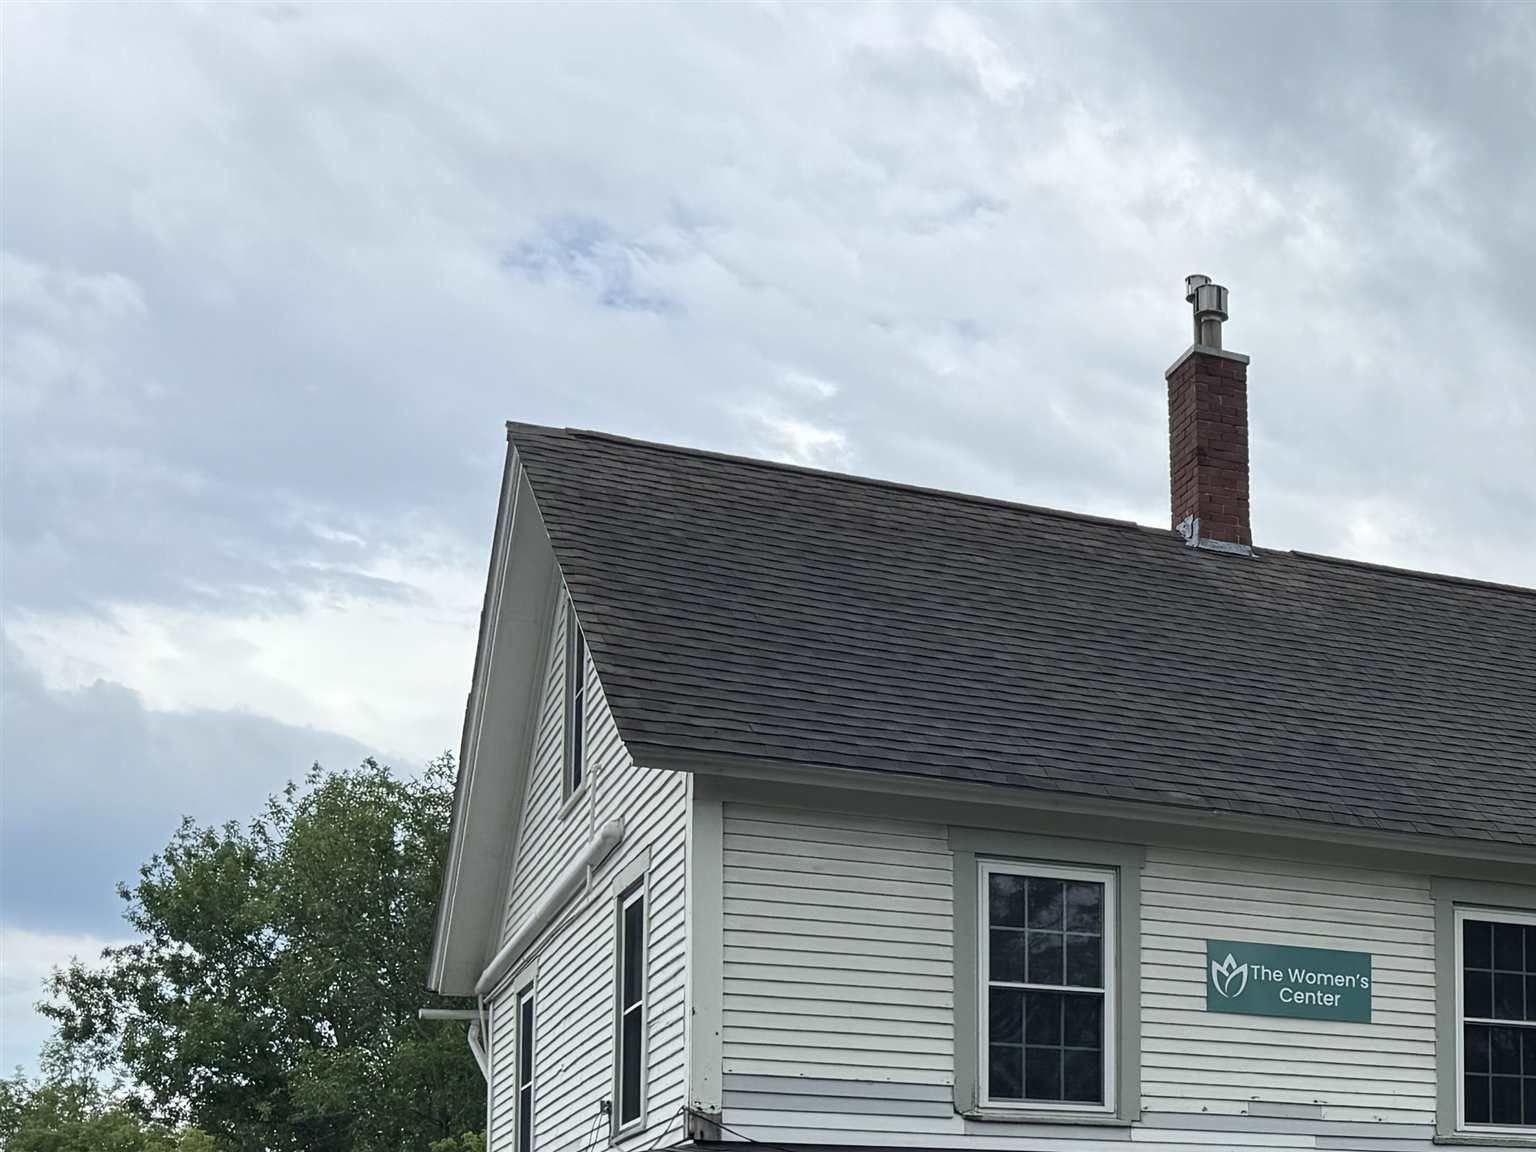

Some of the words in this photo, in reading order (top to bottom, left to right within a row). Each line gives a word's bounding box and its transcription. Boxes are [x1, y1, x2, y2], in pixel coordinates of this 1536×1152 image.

[1250, 965, 1283, 982] The
[1288, 968, 1369, 989] Women's
[1279, 987, 1341, 1007] Center
